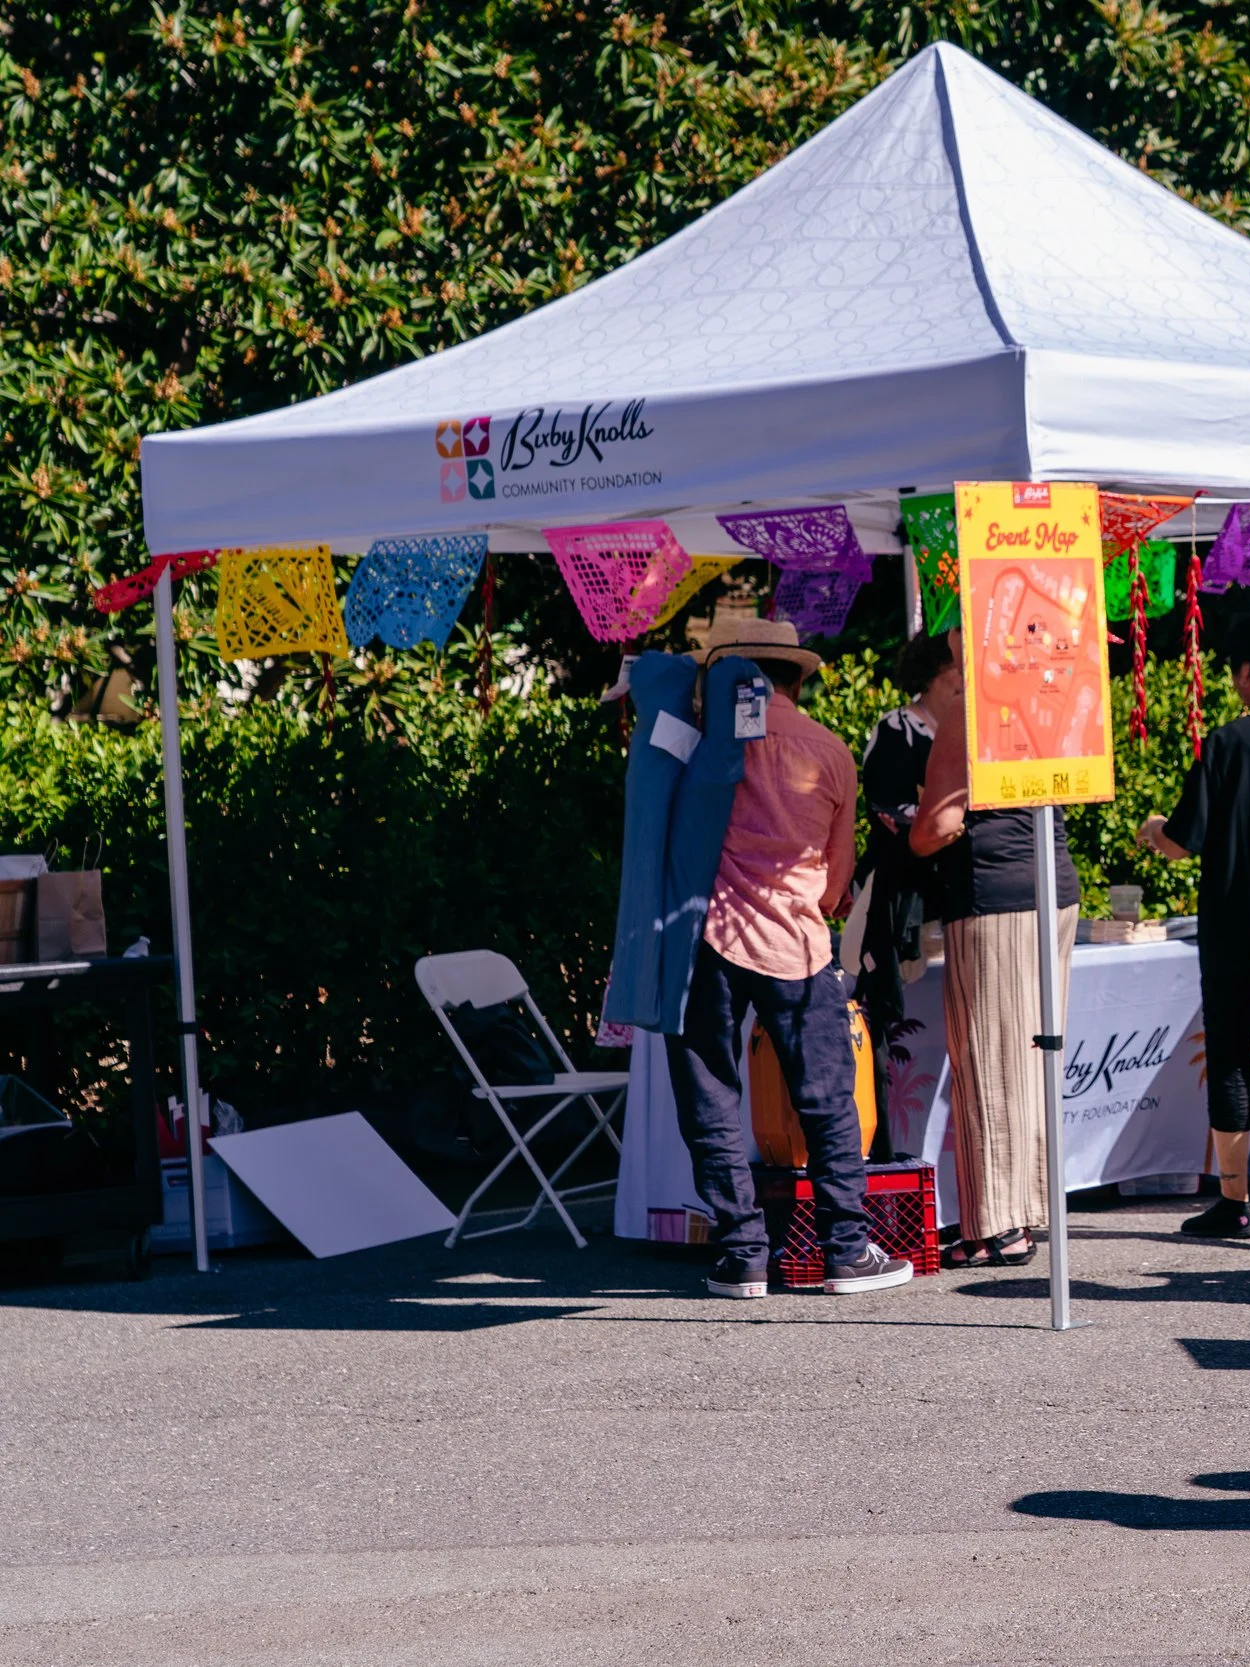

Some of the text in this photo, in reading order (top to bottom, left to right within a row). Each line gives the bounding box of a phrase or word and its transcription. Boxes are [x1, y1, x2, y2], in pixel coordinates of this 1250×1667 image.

[501, 398, 654, 471] Bixby Knolls
[502, 471, 662, 498] COMMUNITY FOUNDATION
[985, 522, 1079, 553] Event Map
[1062, 1025, 1172, 1100] Knolls
